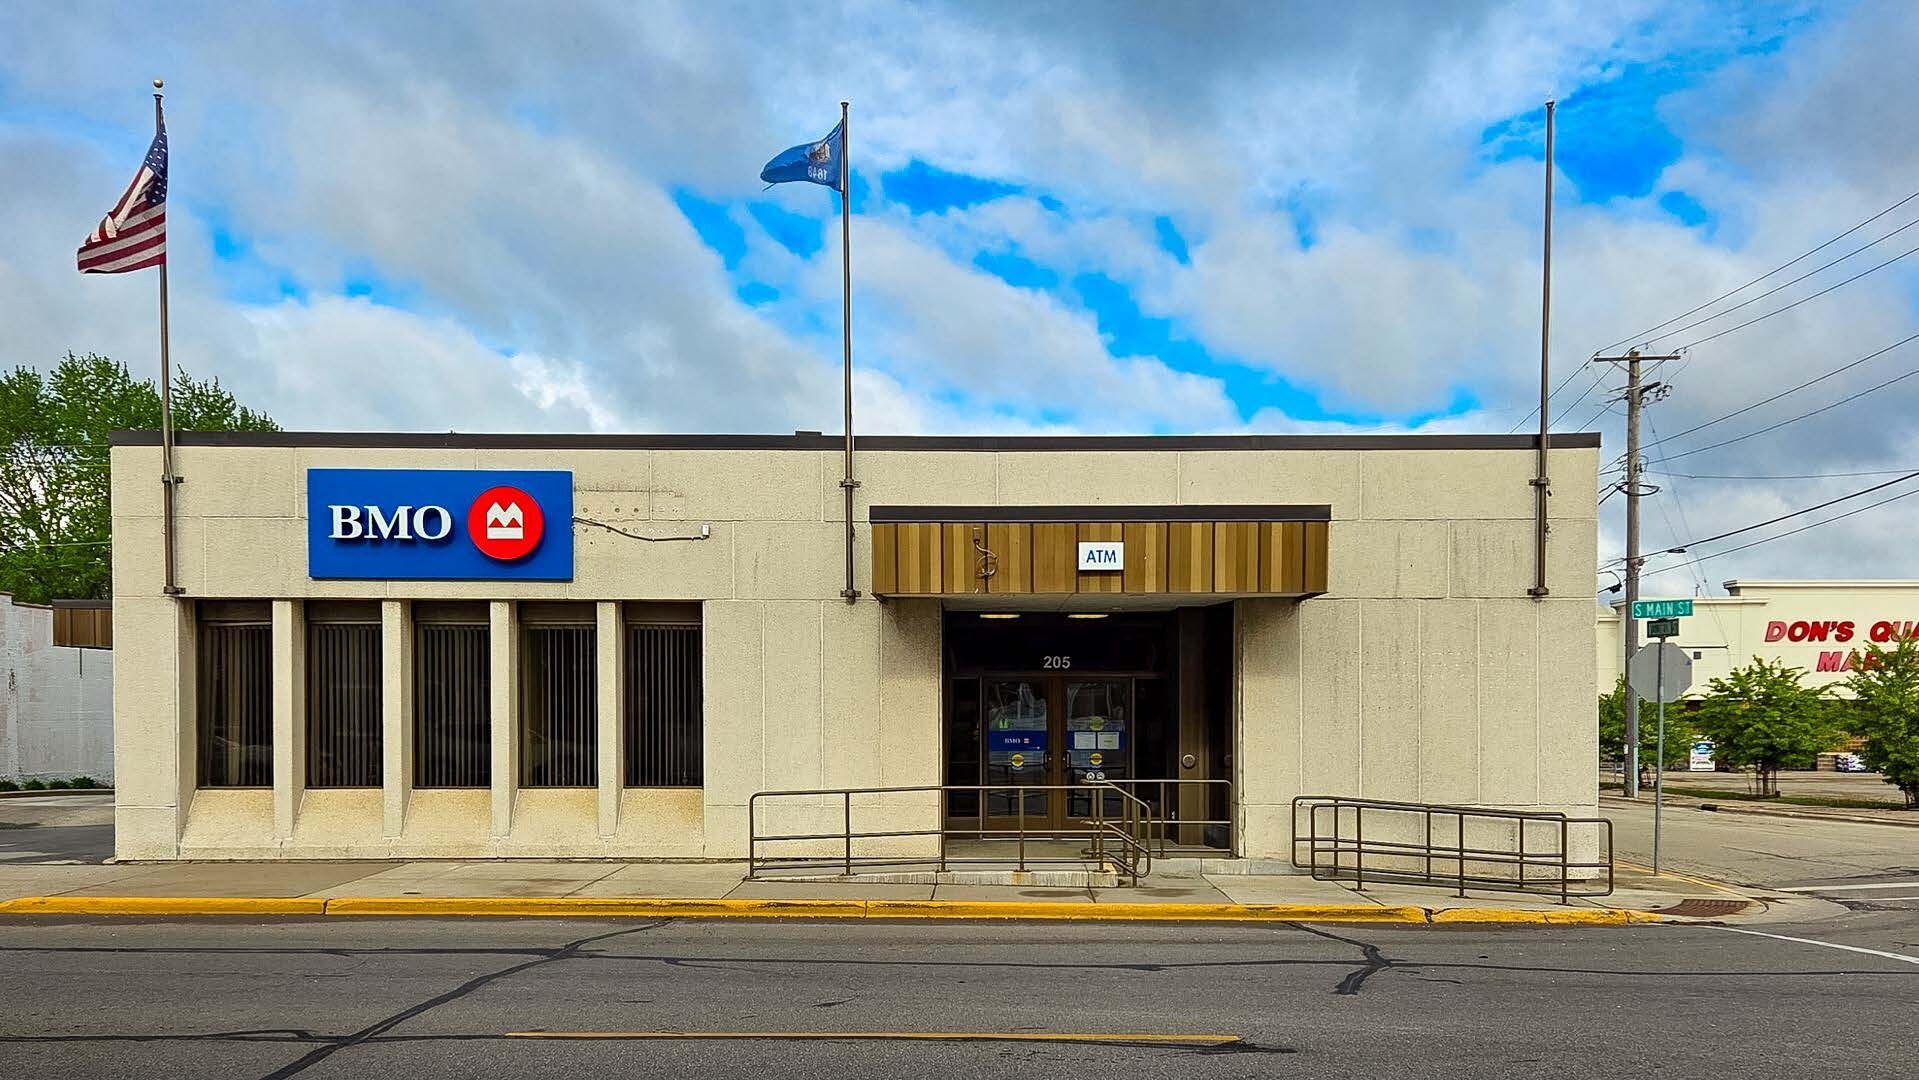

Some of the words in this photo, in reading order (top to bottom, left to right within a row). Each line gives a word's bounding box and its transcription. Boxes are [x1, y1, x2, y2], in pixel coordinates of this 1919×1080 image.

[328, 504, 452, 540] BMO
[1086, 549, 1117, 564] ATM
[1634, 603, 1642, 617] S
[1646, 601, 1674, 617] MAIN
[1678, 600, 1690, 615] ST
[1764, 620, 1856, 643] DON'S
[1043, 655, 1071, 669] 205
